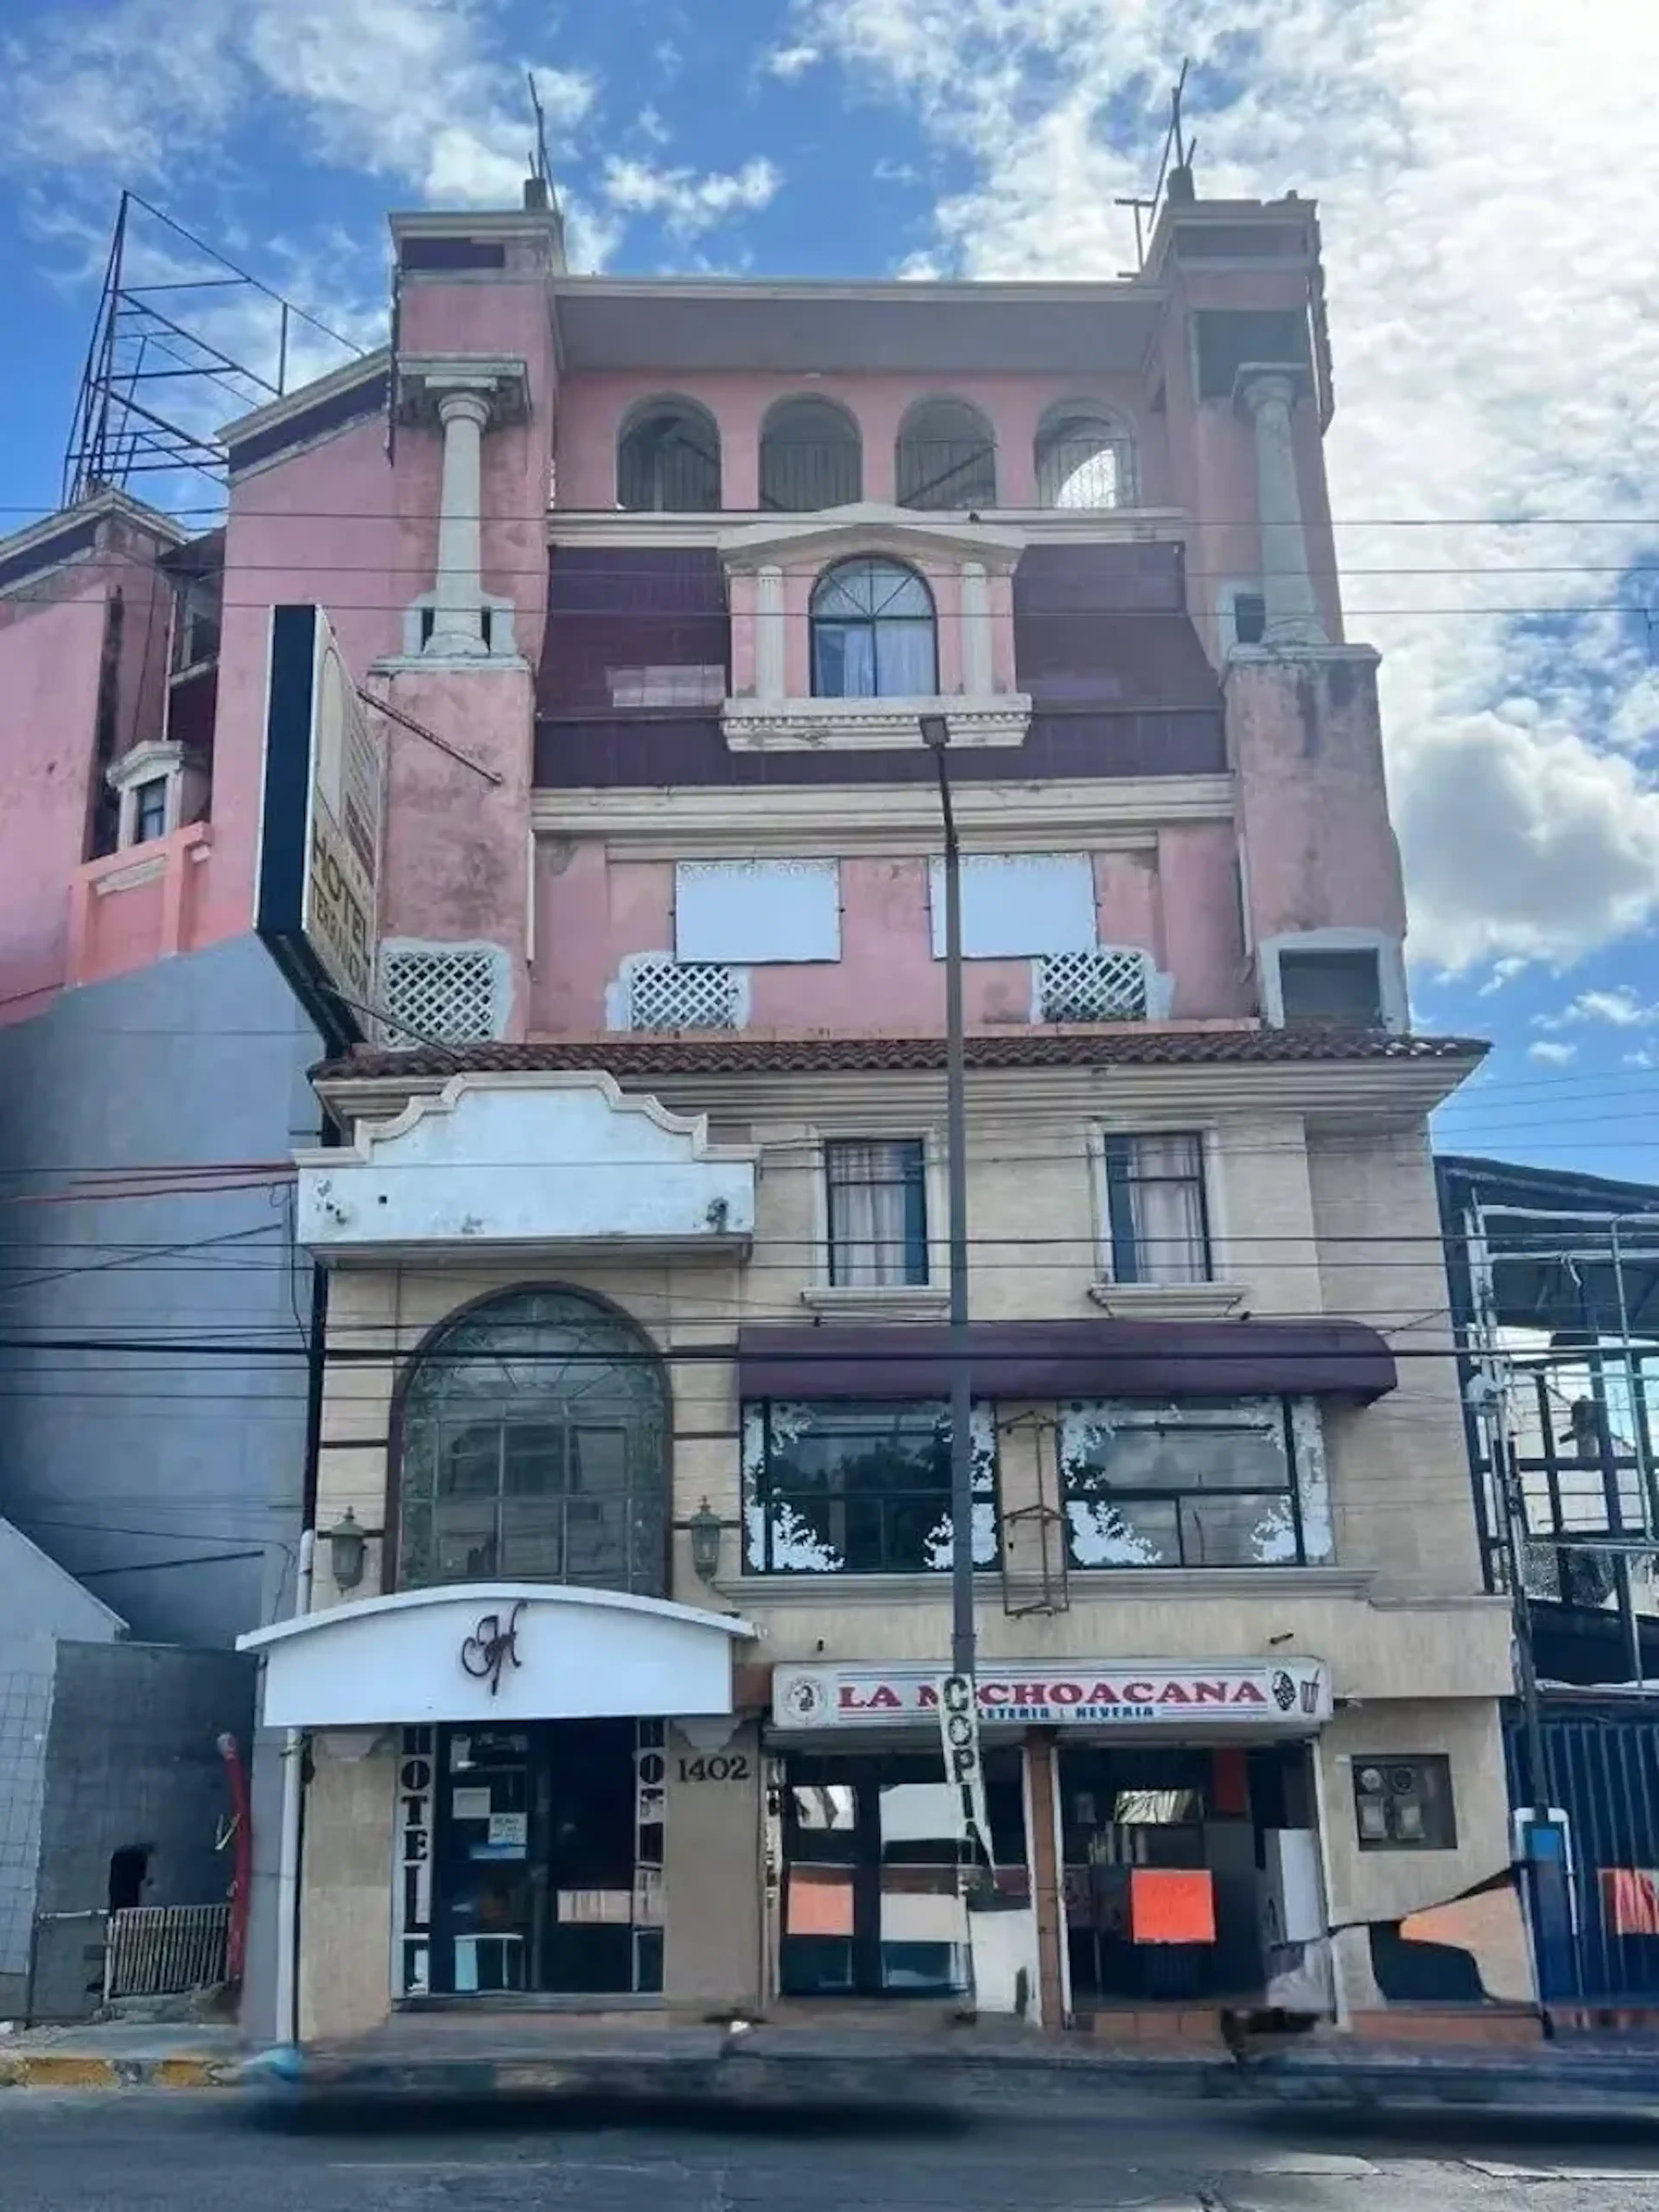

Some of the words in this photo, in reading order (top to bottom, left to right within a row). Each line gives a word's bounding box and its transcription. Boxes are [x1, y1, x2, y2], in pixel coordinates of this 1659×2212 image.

[313, 819, 371, 968] HOTEL
[839, 1686, 902, 1707] LA
[678, 1754, 750, 1783] 1402
